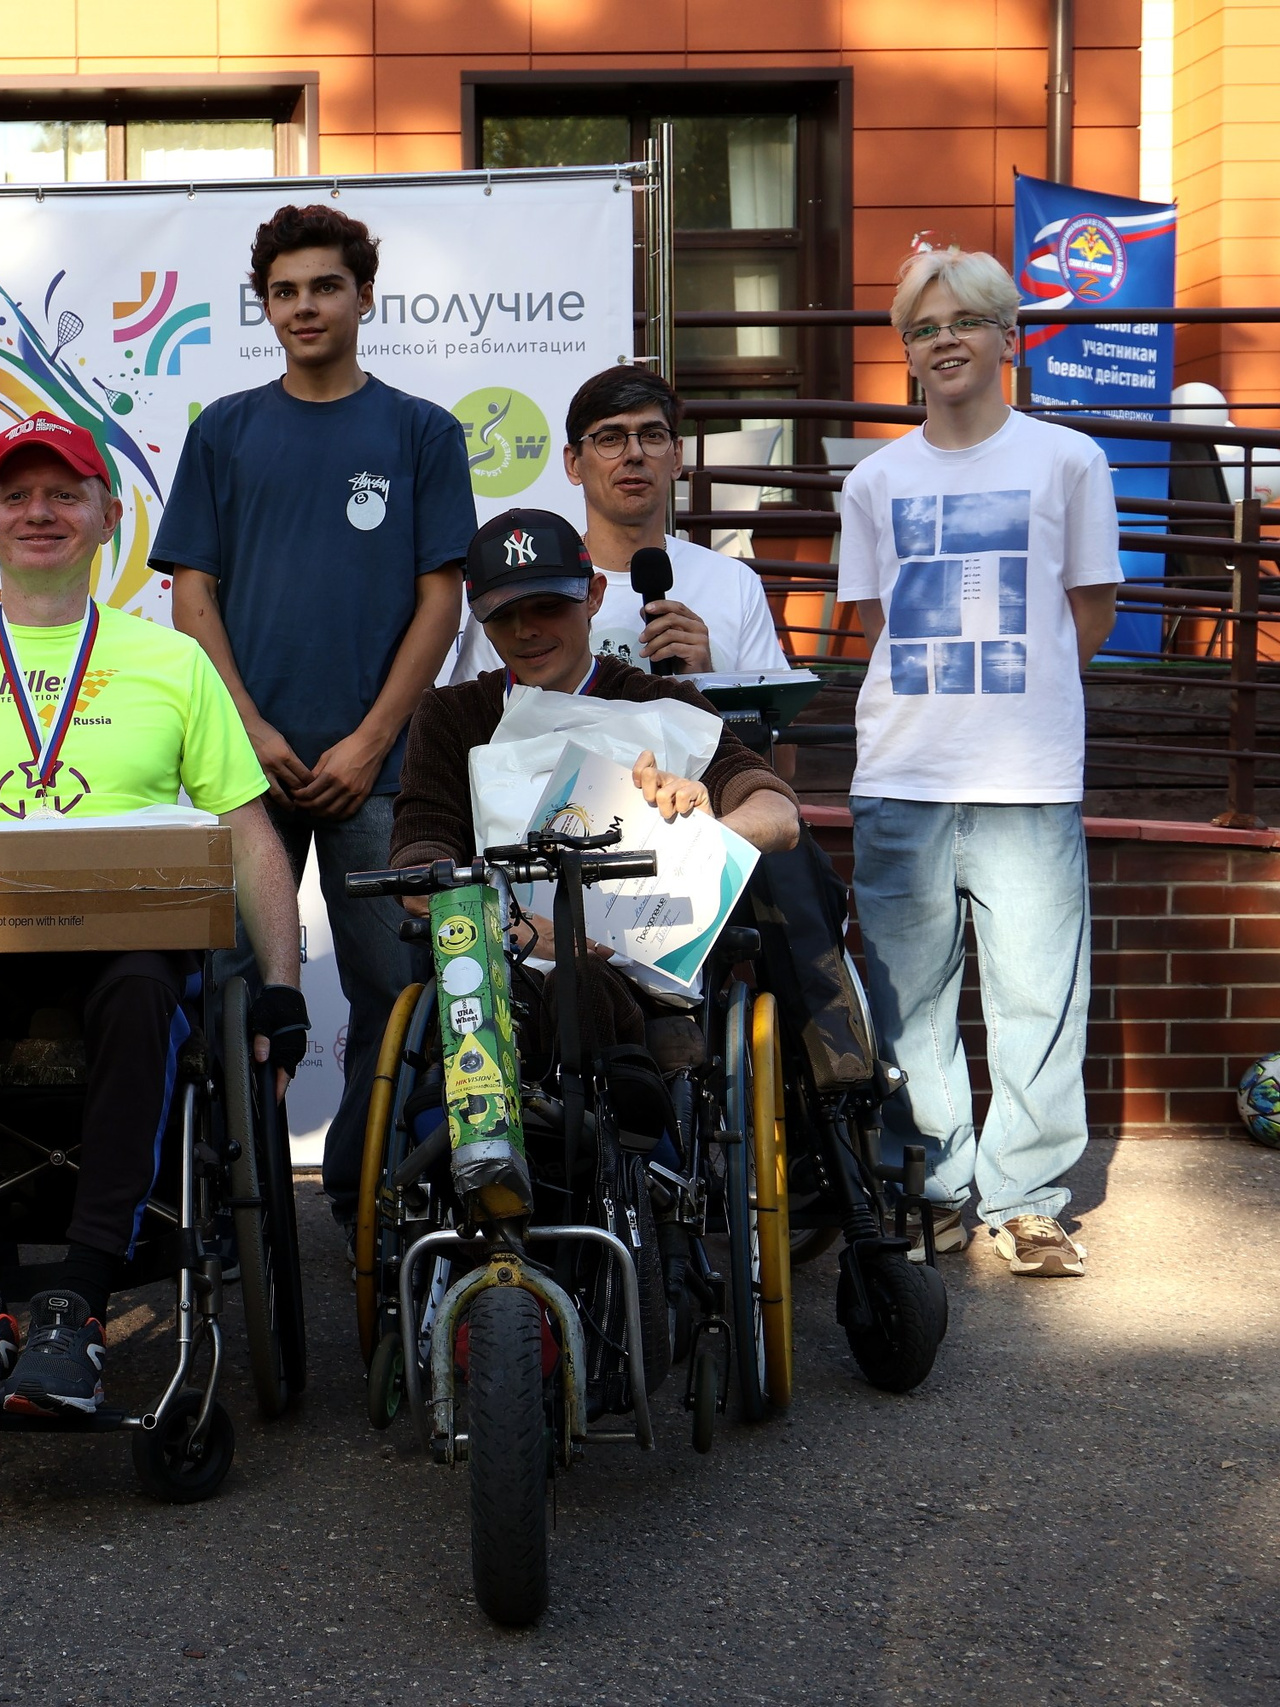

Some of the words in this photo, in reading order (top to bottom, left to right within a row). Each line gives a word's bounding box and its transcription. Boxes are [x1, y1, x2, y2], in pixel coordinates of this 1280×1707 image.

[239, 284, 585, 336] Бополучие
[240, 345, 285, 358] цент
[356, 339, 437, 356] цинской
[445, 338, 586, 358] реабилитации
[1082, 339, 1157, 363] участникам
[1047, 355, 1093, 381] боевых
[1094, 365, 1156, 390] действий
[4, 419, 35, 440] 100
[73, 716, 112, 726] Russia
[8, 917, 33, 929] open
[35, 915, 56, 926] with
[58, 915, 84, 926] knife!
[455, 1014, 479, 1025] Wheel
[457, 1008, 474, 1017] UNA
[455, 1075, 492, 1087] HIKVISION
